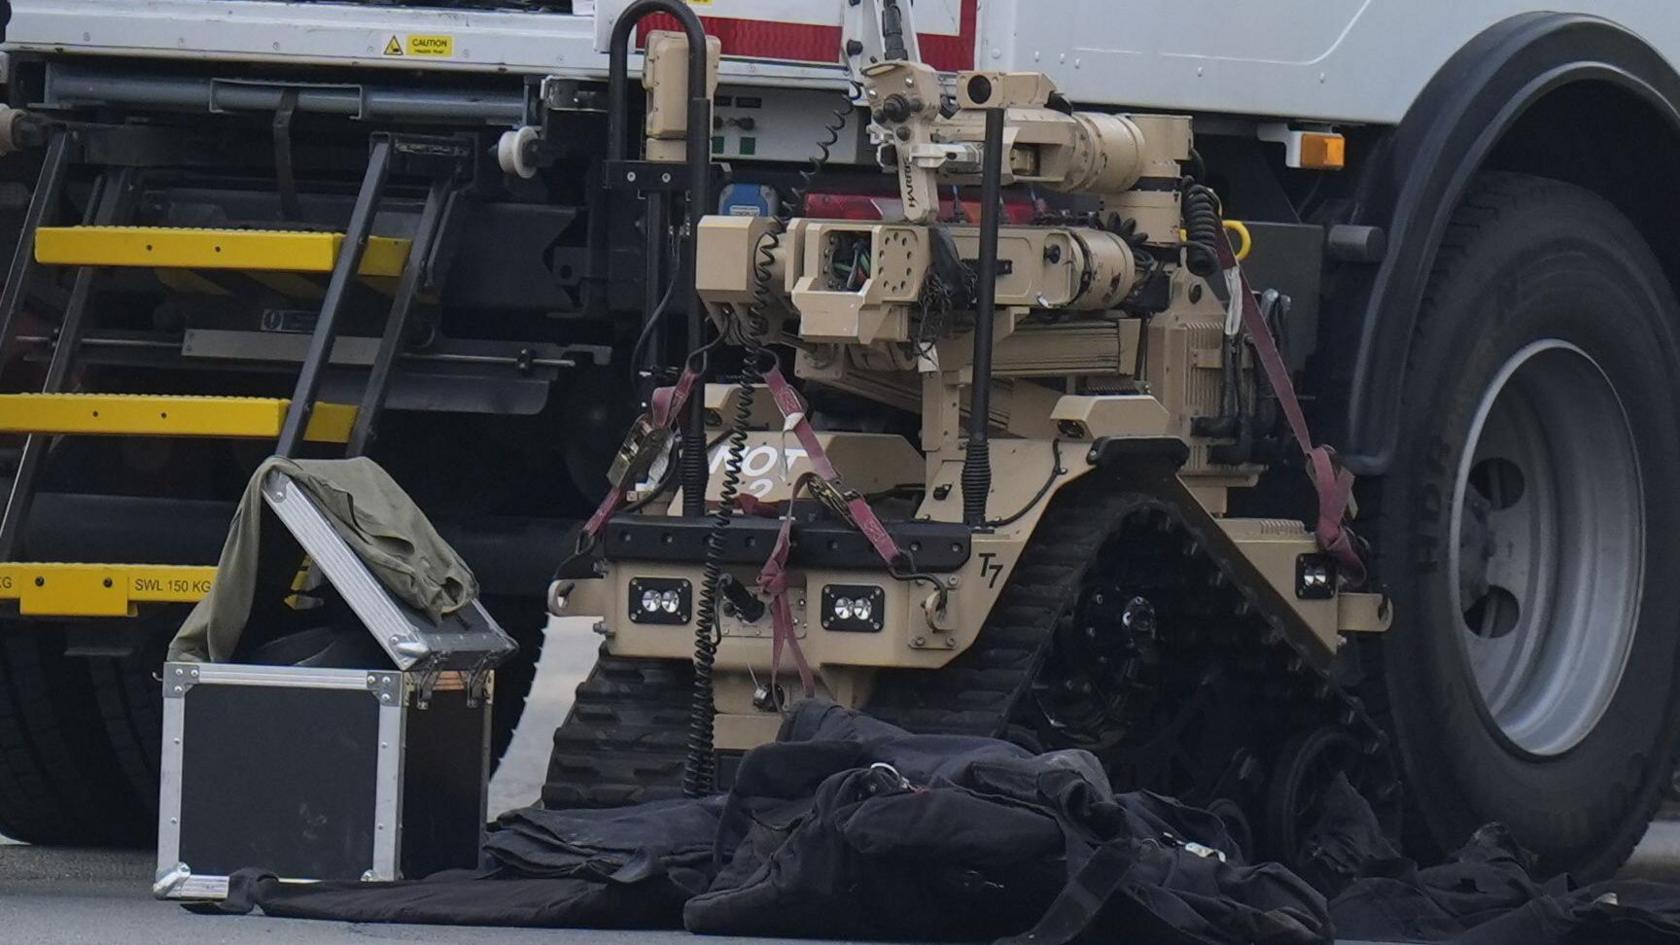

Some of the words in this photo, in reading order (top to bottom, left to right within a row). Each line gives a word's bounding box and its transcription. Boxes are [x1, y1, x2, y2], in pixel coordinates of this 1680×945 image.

[412, 39, 447, 48] CAUTION
[978, 552, 1004, 589] T7
[0, 576, 12, 589] G
[135, 579, 163, 591] SWL
[168, 580, 189, 592] 150
[192, 580, 211, 593] KG
